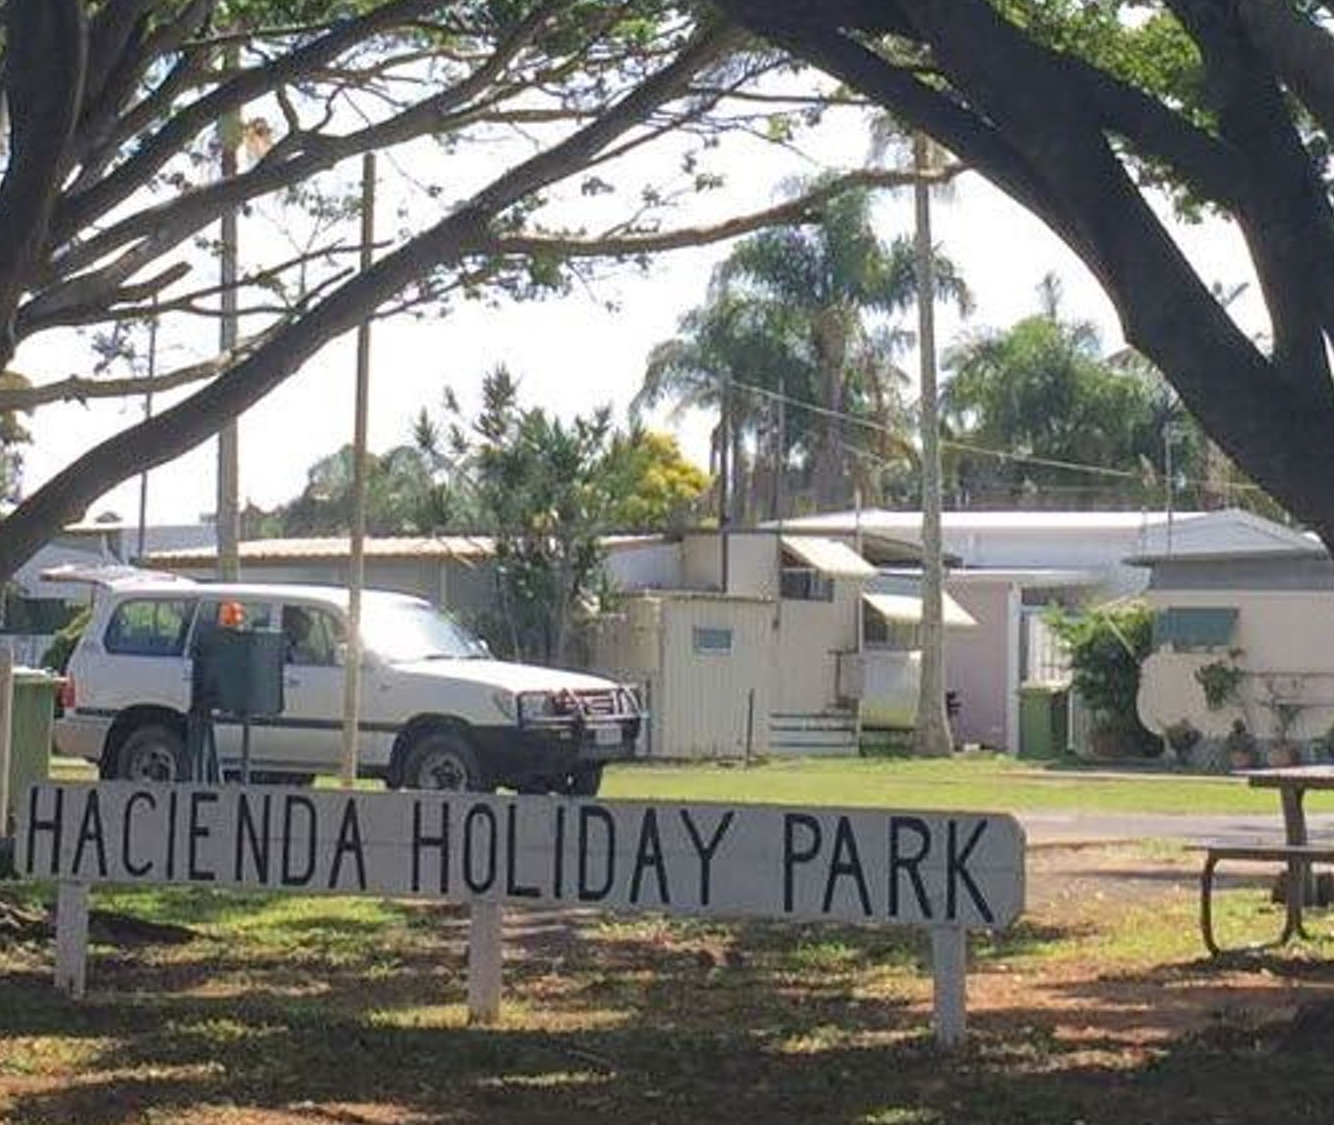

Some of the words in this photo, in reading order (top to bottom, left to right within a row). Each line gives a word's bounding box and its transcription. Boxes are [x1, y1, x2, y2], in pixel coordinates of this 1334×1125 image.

[27, 786, 369, 890] HACIENDA
[411, 800, 734, 906] HOLIDAY
[782, 813, 995, 923] PARK
